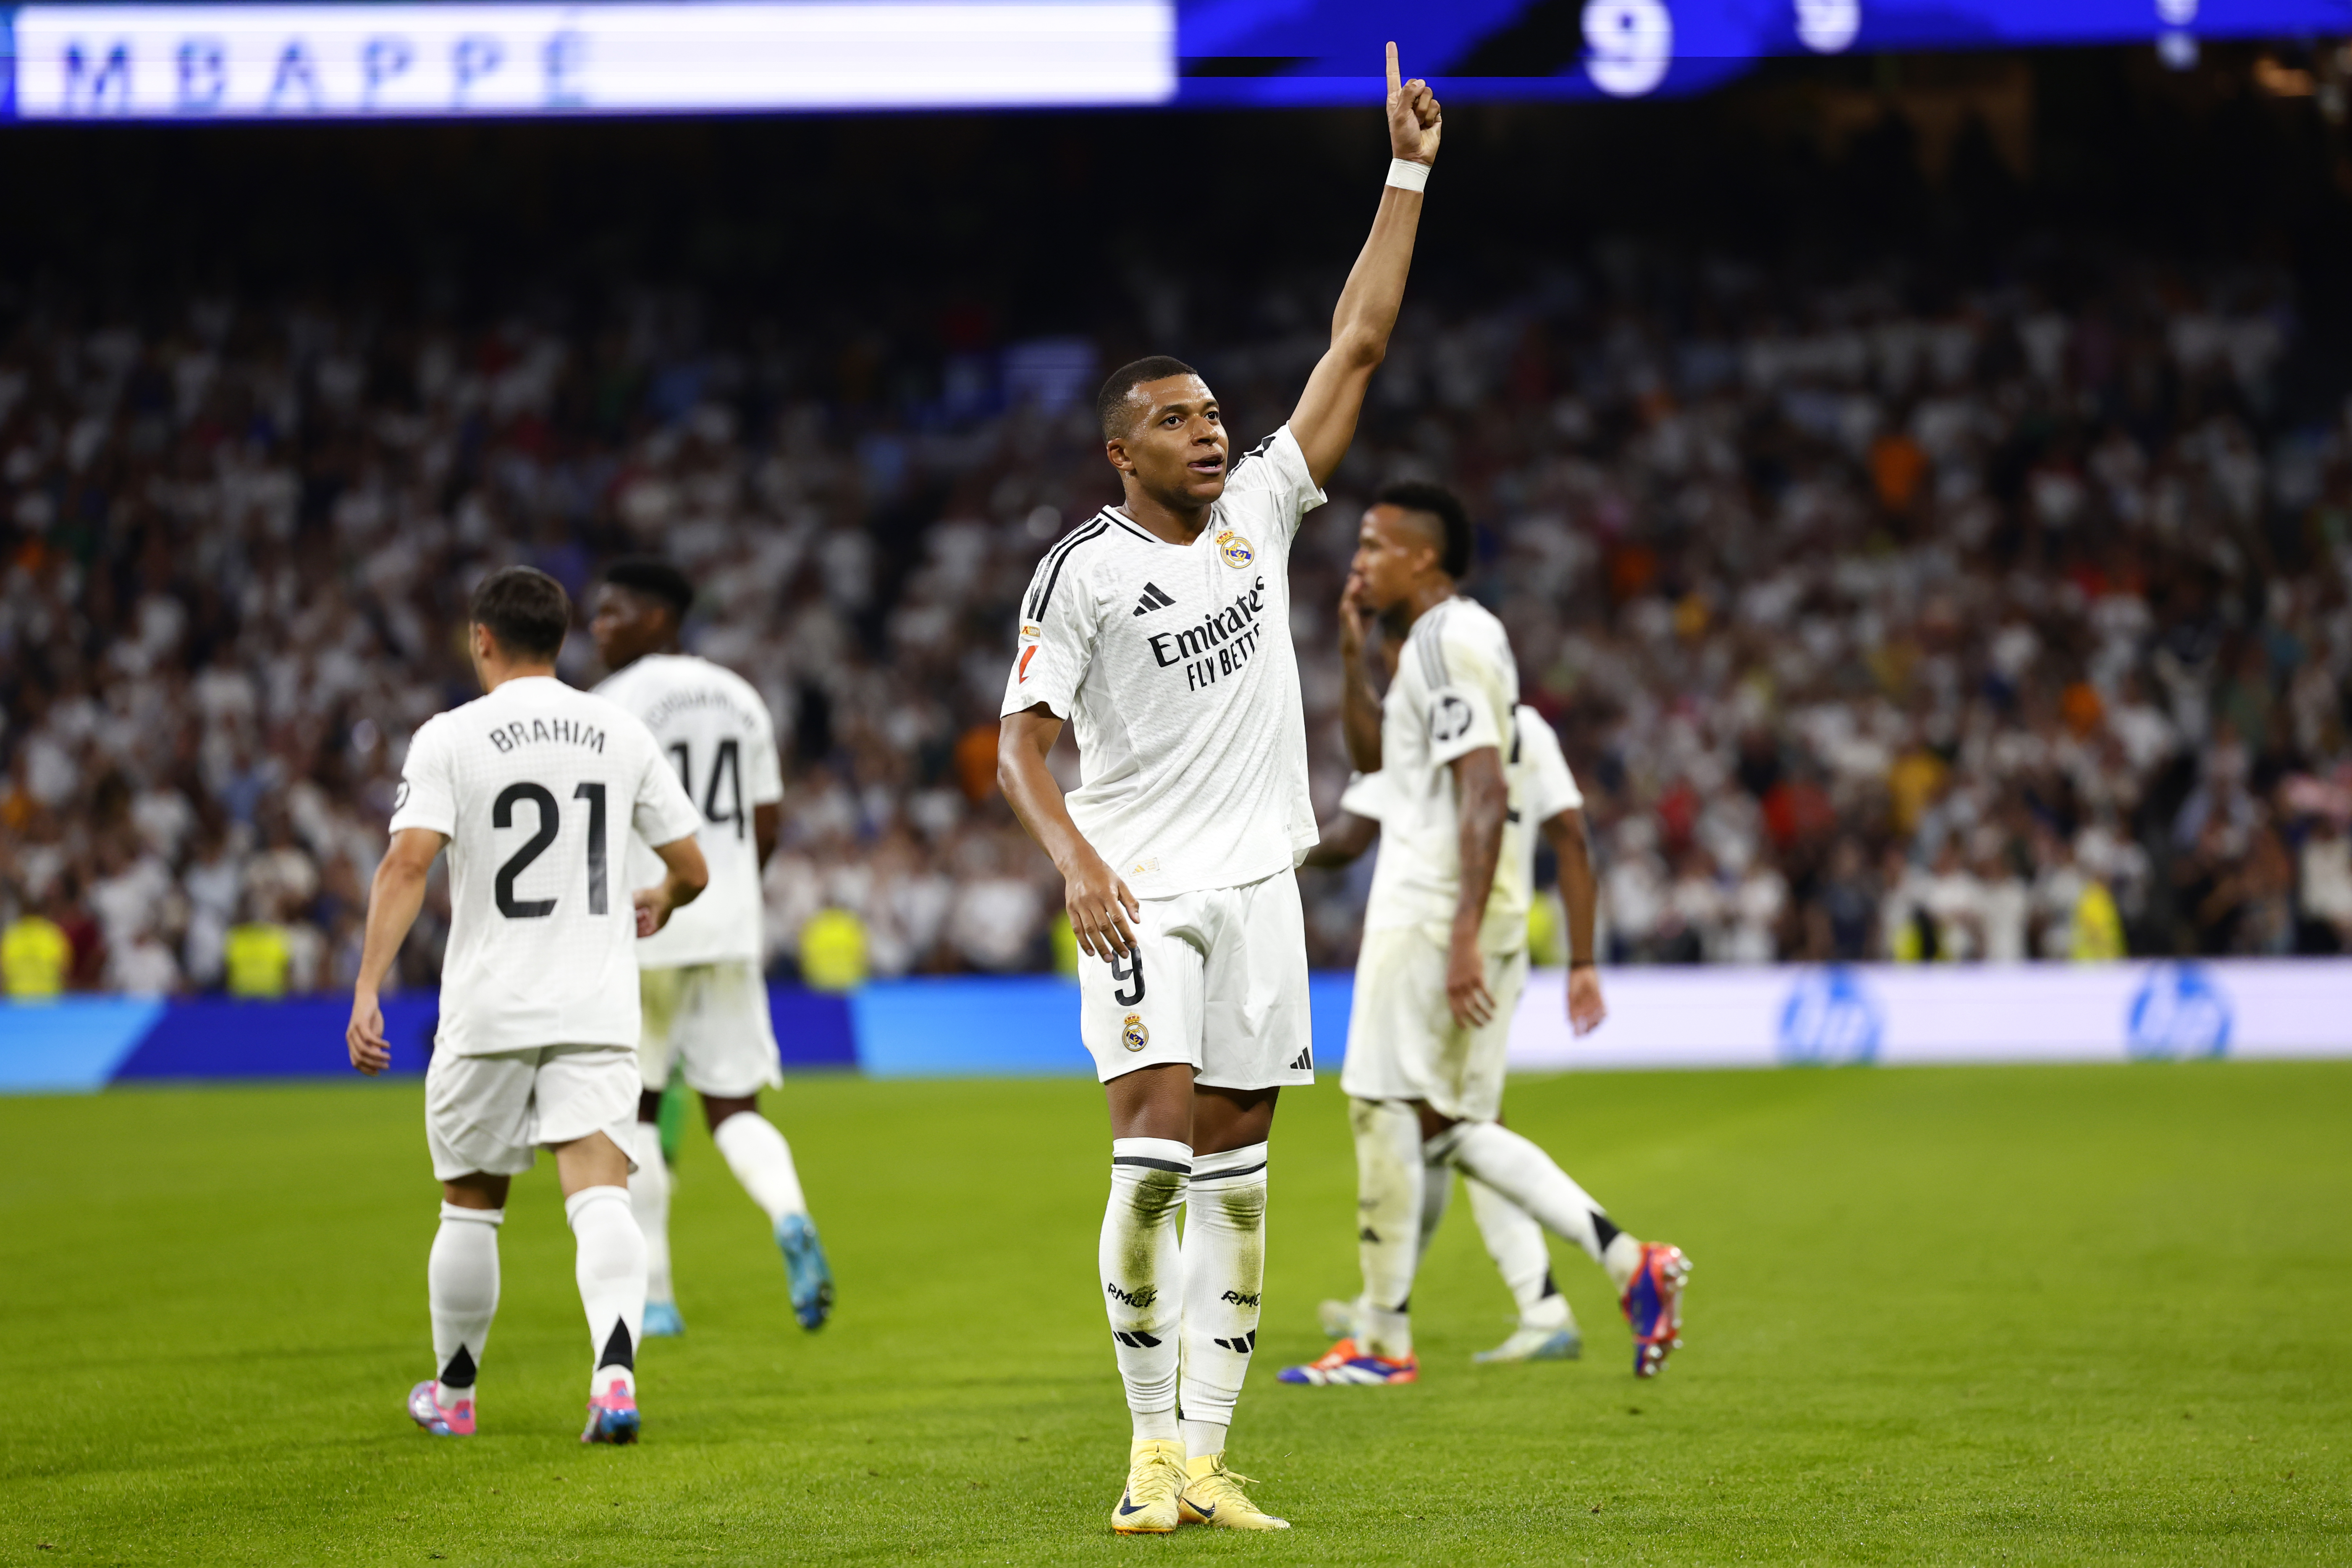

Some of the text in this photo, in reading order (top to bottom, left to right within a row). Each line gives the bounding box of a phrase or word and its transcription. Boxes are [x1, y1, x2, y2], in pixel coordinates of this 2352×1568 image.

[1147, 576, 1264, 668] Emirates
[1187, 656, 1215, 691] FLY
[488, 718, 606, 755] BRAHIM
[668, 737, 746, 840] 14
[492, 781, 608, 919] 21
[1111, 941, 1146, 1007] 9
